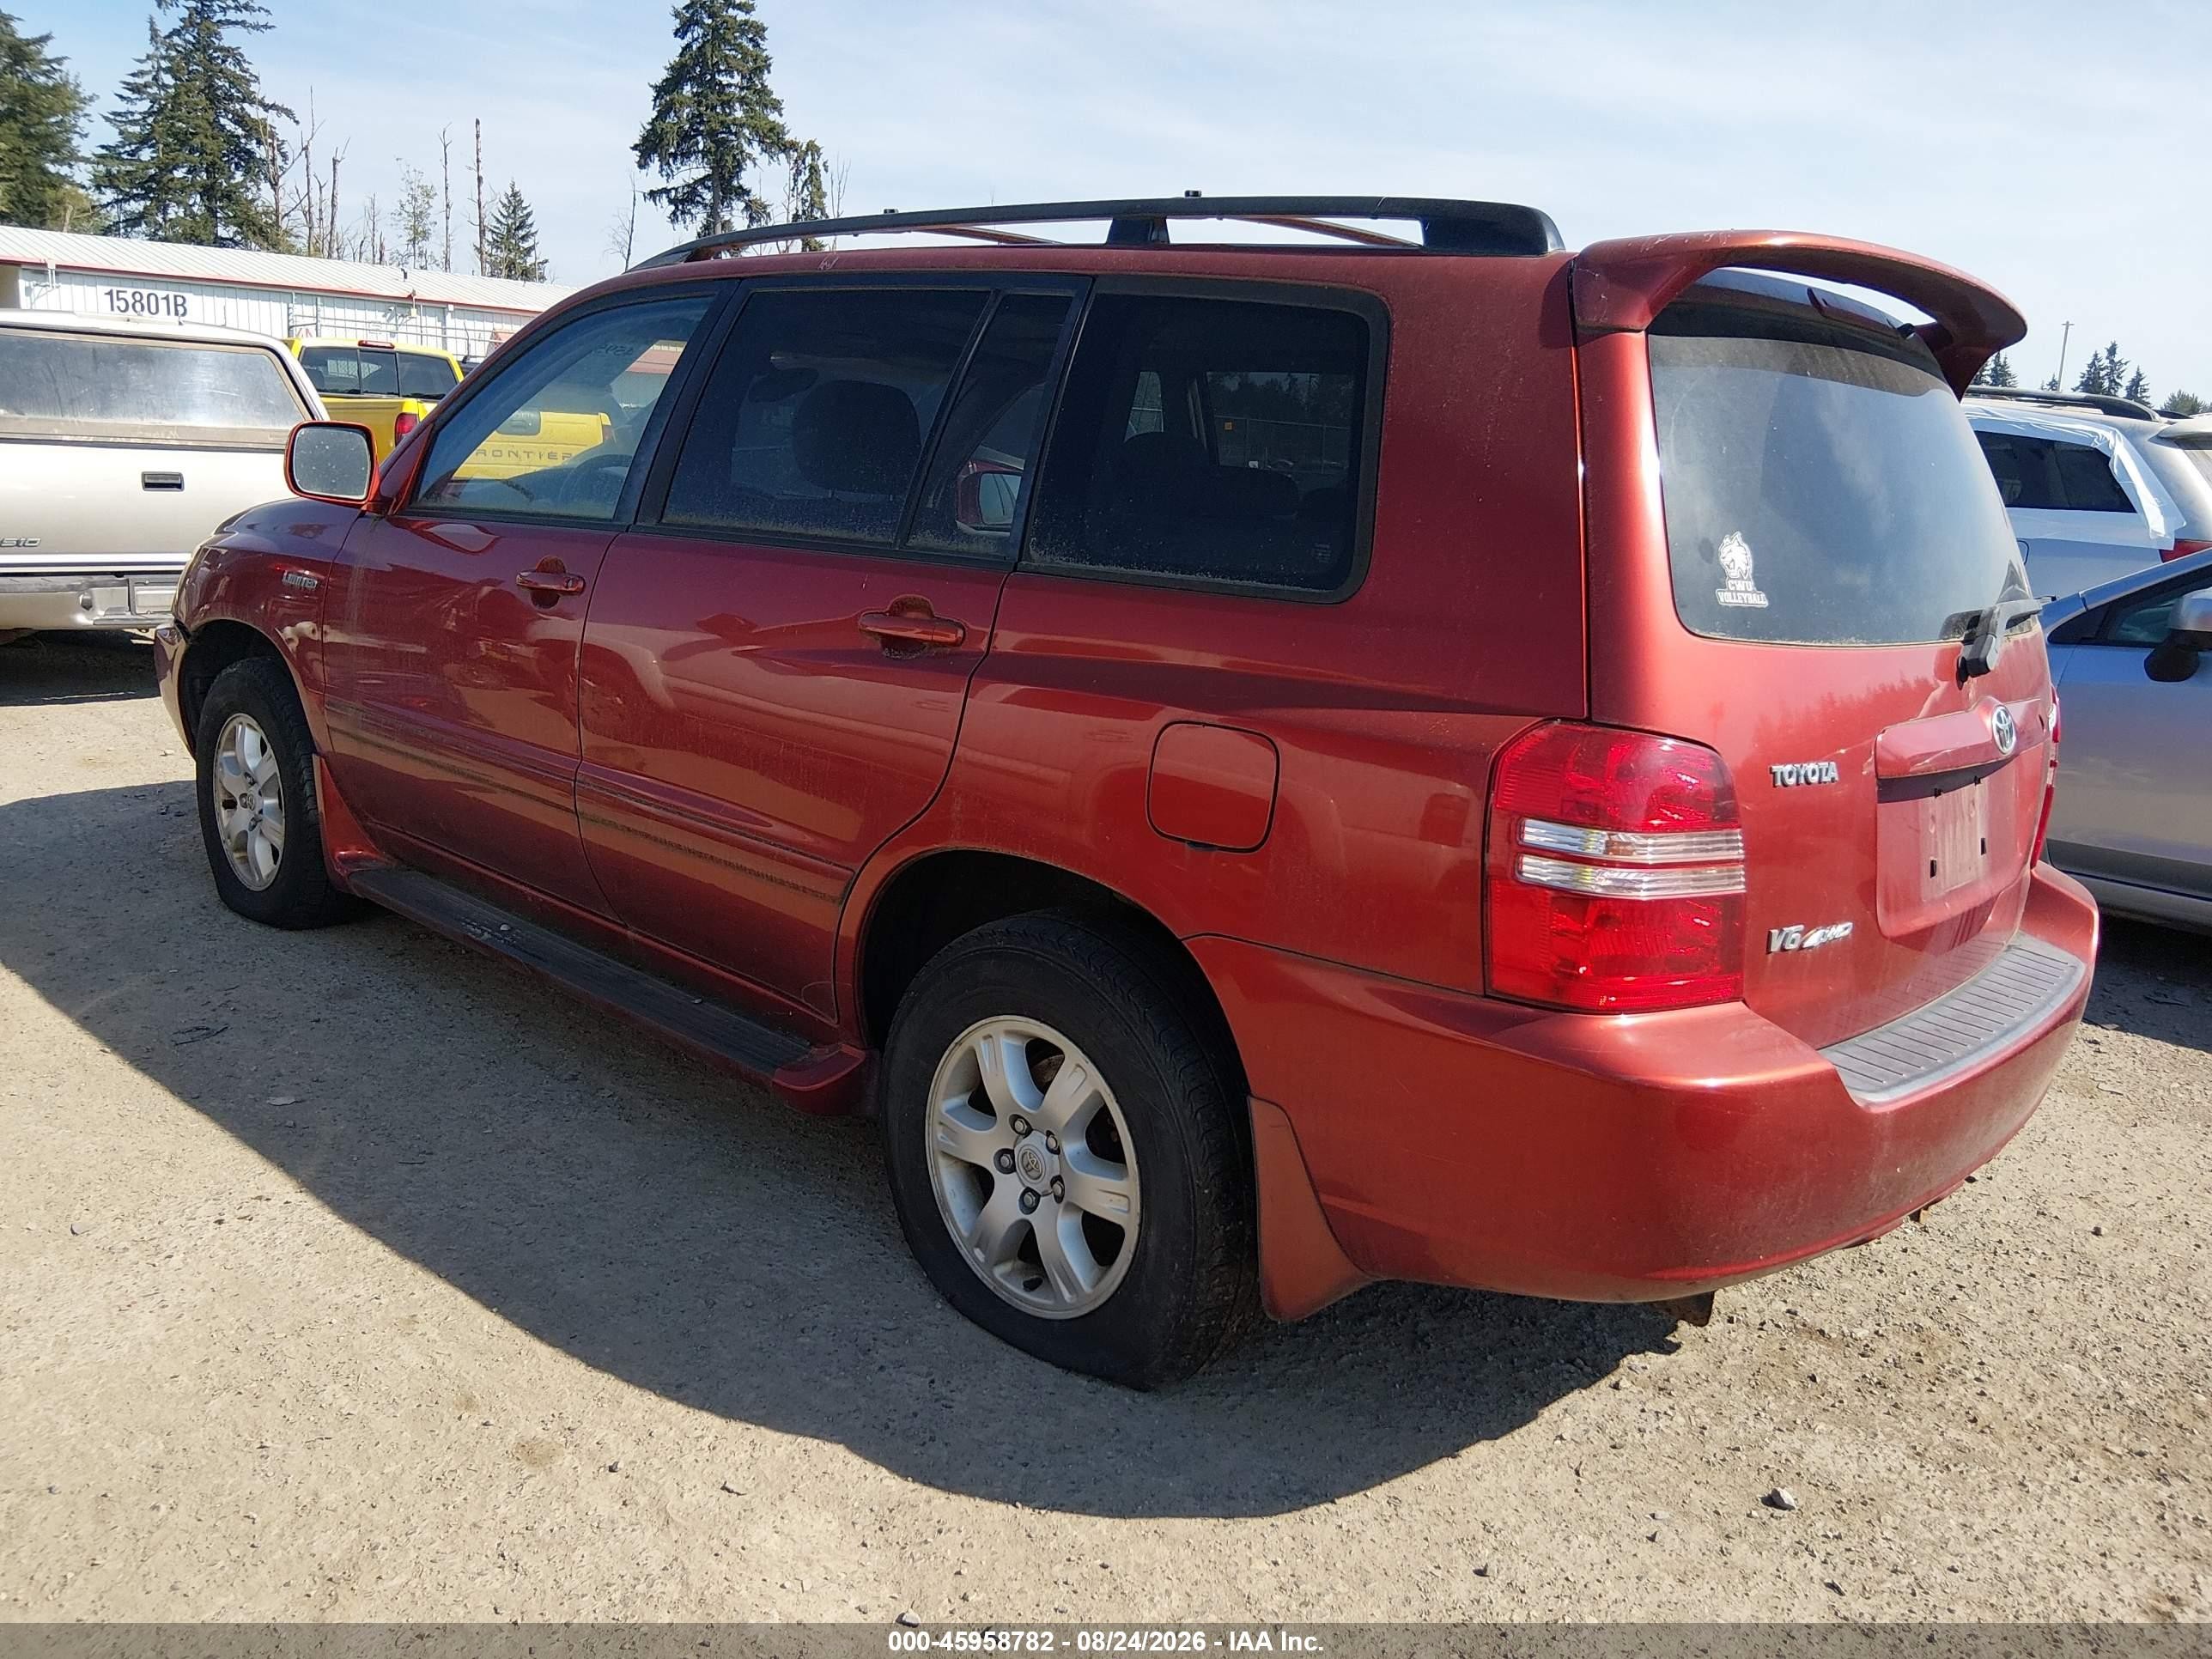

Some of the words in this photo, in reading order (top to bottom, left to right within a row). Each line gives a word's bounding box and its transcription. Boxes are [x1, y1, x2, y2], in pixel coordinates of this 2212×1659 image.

[104, 289, 188, 318] 15801B
[1717, 591, 1767, 605] VOLLEYBALL
[1728, 580, 1753, 592] CWU
[1770, 762, 1838, 787] TOYOTA
[1767, 924, 1804, 953] V6
